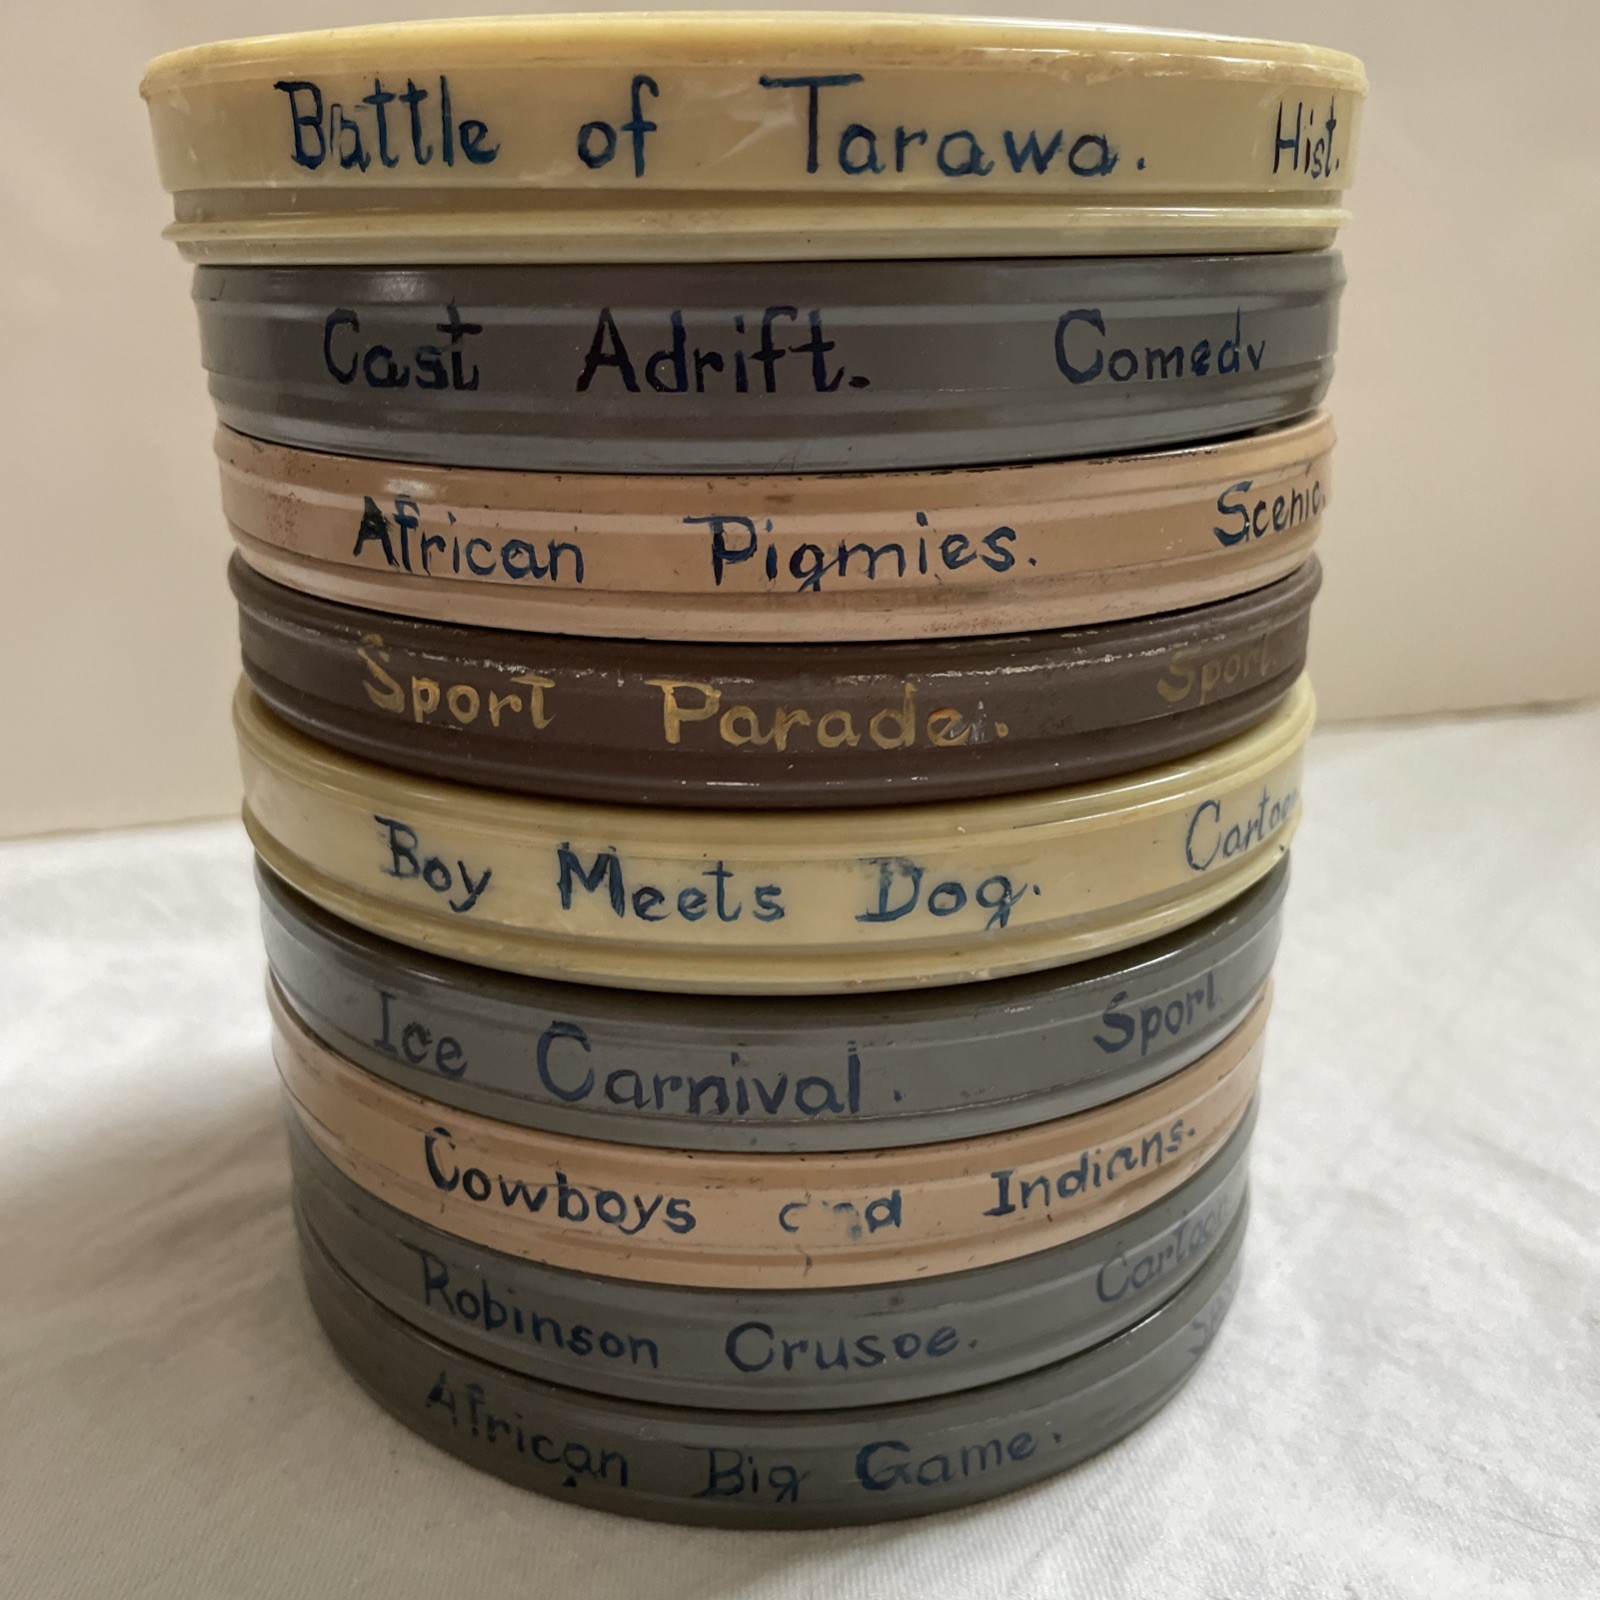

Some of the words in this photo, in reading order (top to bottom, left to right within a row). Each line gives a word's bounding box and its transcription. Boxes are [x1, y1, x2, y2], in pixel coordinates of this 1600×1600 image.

[274, 75, 499, 172] Battle
[576, 75, 659, 178] of
[759, 74, 1147, 178] Tarawa.
[1272, 96, 1341, 179] Hist.
[323, 300, 483, 392] Cast
[575, 305, 871, 394] Adrift.
[353, 495, 585, 584] African
[683, 511, 1037, 593] Pigmies.
[357, 634, 556, 730] Sport
[645, 683, 1009, 752] Parade.
[373, 814, 492, 913] Boy
[556, 842, 787, 922] Meets
[855, 857, 1042, 931] Dog.
[373, 991, 468, 1079] Ice
[425, 1126, 697, 1234] Cowboys
[778, 1189, 903, 1241] ad
[983, 1117, 1196, 1217] Indians.
[402, 1237, 660, 1369] Robinson
[724, 1321, 978, 1374] Crusoe.
[424, 1370, 630, 1488] African
[693, 1444, 810, 1503] Big
